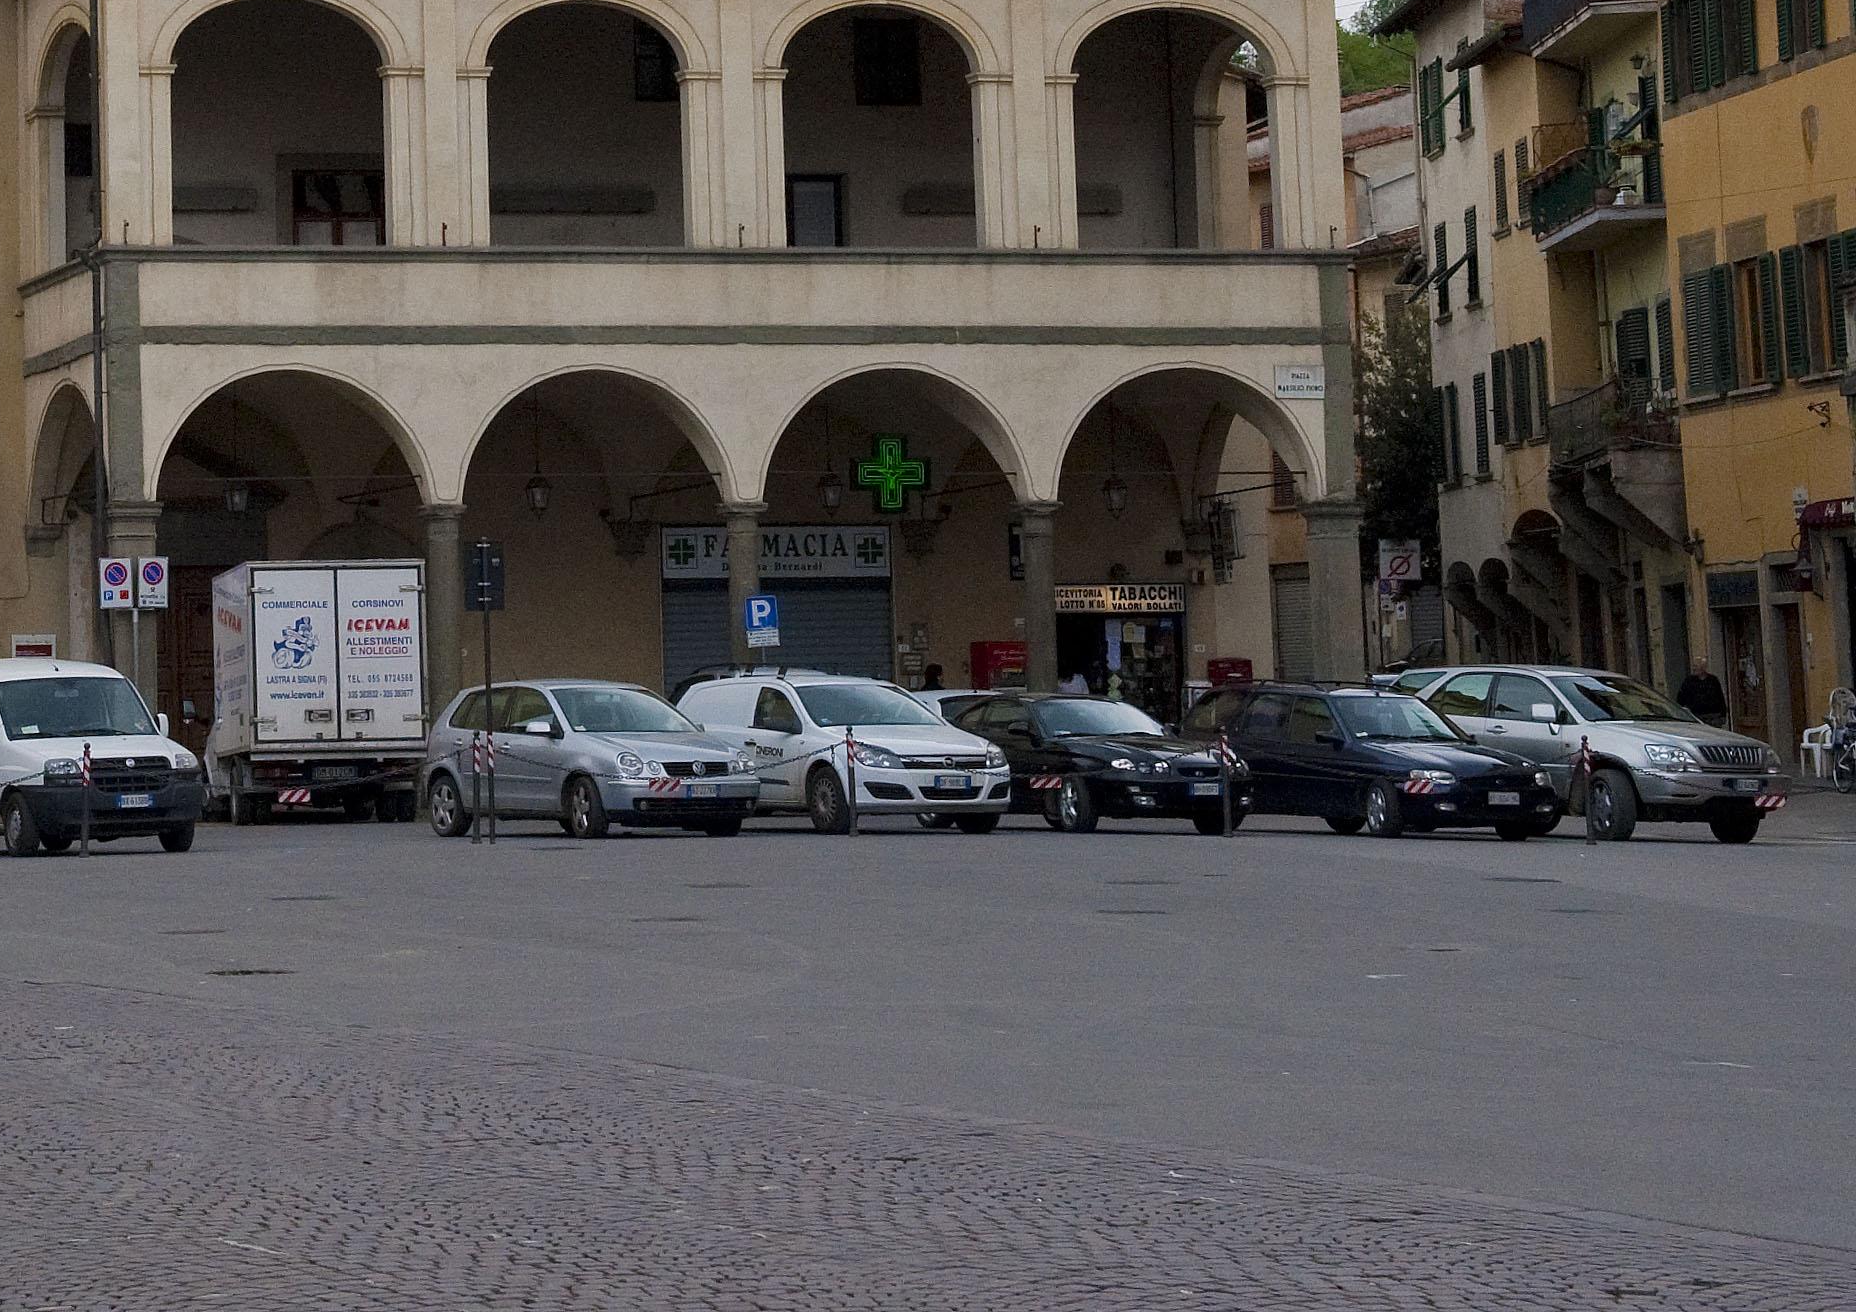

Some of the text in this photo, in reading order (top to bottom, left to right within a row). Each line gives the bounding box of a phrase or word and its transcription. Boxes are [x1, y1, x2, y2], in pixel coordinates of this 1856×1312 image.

[703, 533, 849, 558] FMACIA
[1109, 586, 1183, 601] TABACCHI
[261, 600, 328, 609] COMMERCIALE
[351, 599, 404, 609] CORSINOVI
[1060, 599, 1085, 609] LOTTO
[1111, 602, 1182, 610] VALORI BOLLATI
[751, 599, 771, 627] P
[347, 618, 410, 632] ICEVAN
[346, 636, 413, 646] ALLESTIMENTI
[350, 646, 409, 655] E NOLEGGIO
[266, 675, 291, 684] LASTRA
